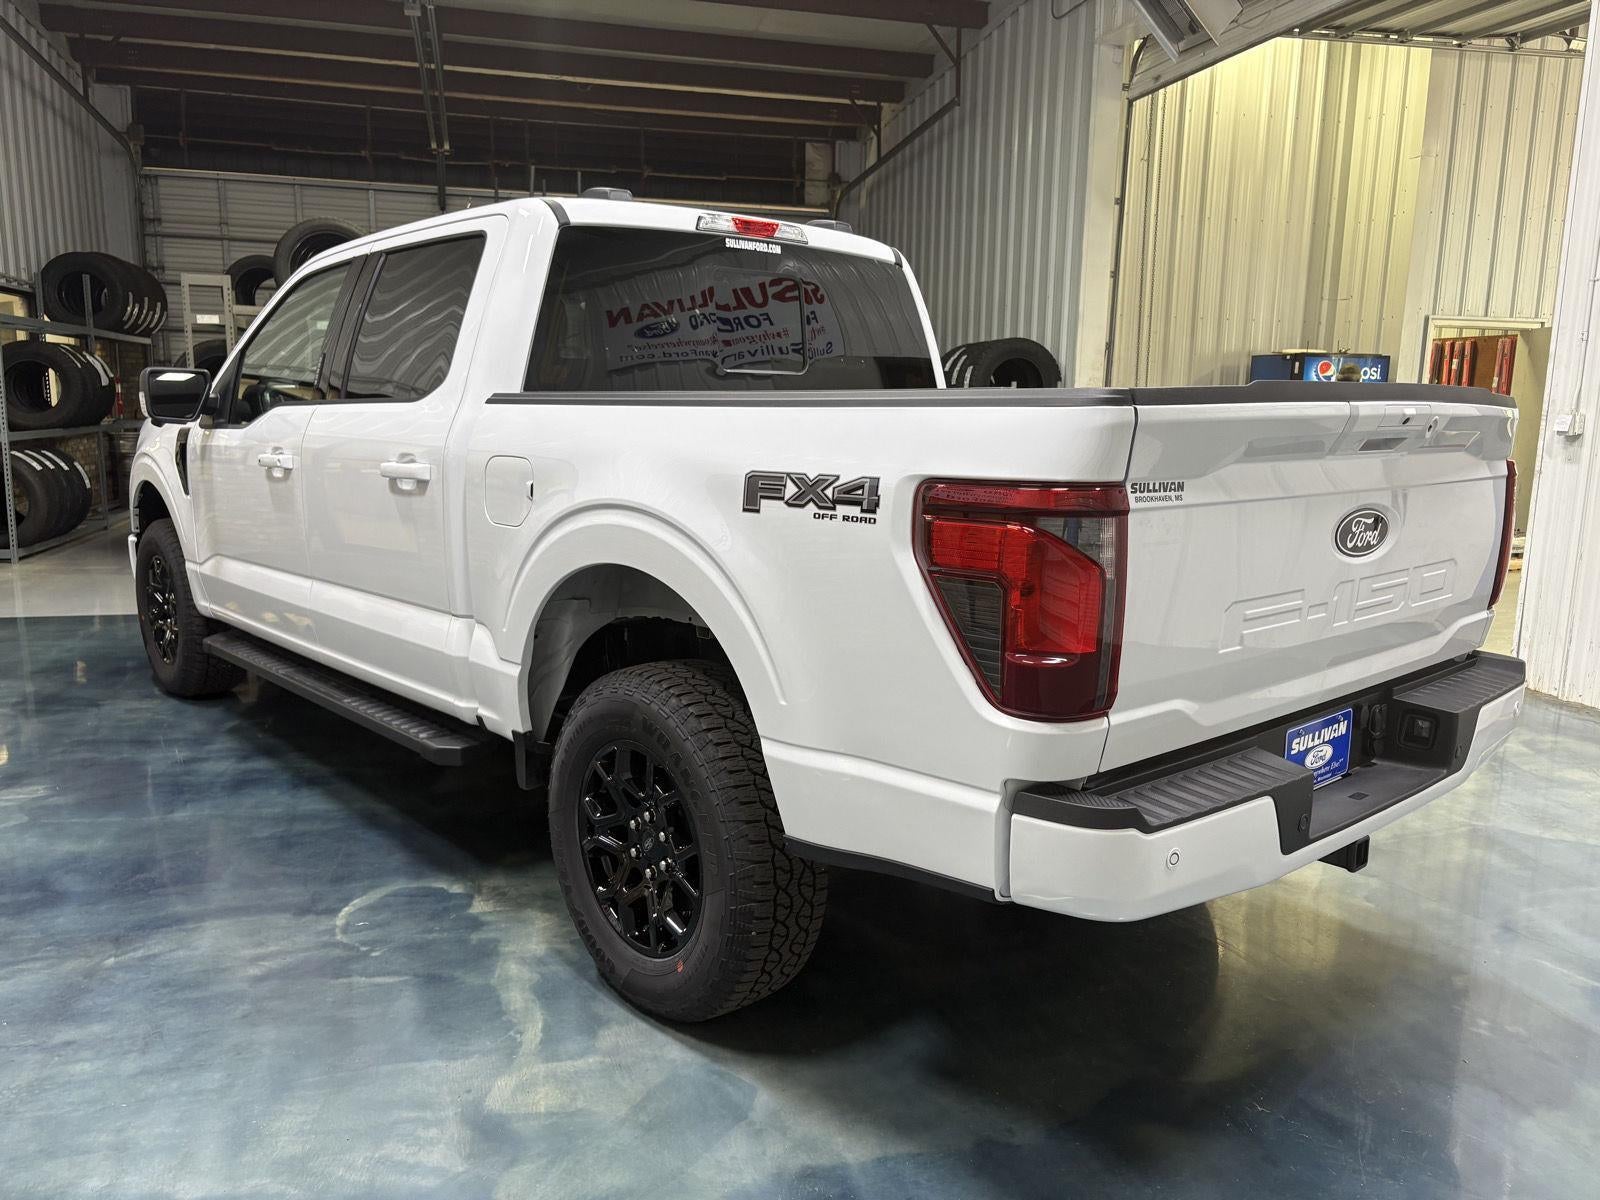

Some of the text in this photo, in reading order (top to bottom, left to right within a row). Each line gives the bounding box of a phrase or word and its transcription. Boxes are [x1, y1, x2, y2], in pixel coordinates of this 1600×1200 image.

[725, 238, 781, 254] SULLIVANFORD.COM
[1360, 365, 1381, 382] psi
[742, 470, 880, 514] FX4
[1131, 481, 1184, 494] SULLIVAN
[1135, 495, 1174, 503] BROOKHAVEN,
[813, 512, 877, 525] OFF ROAD
[1346, 516, 1382, 549] Ford
[1219, 559, 1457, 654] F-150
[1291, 720, 1348, 755] SULLIVAN
